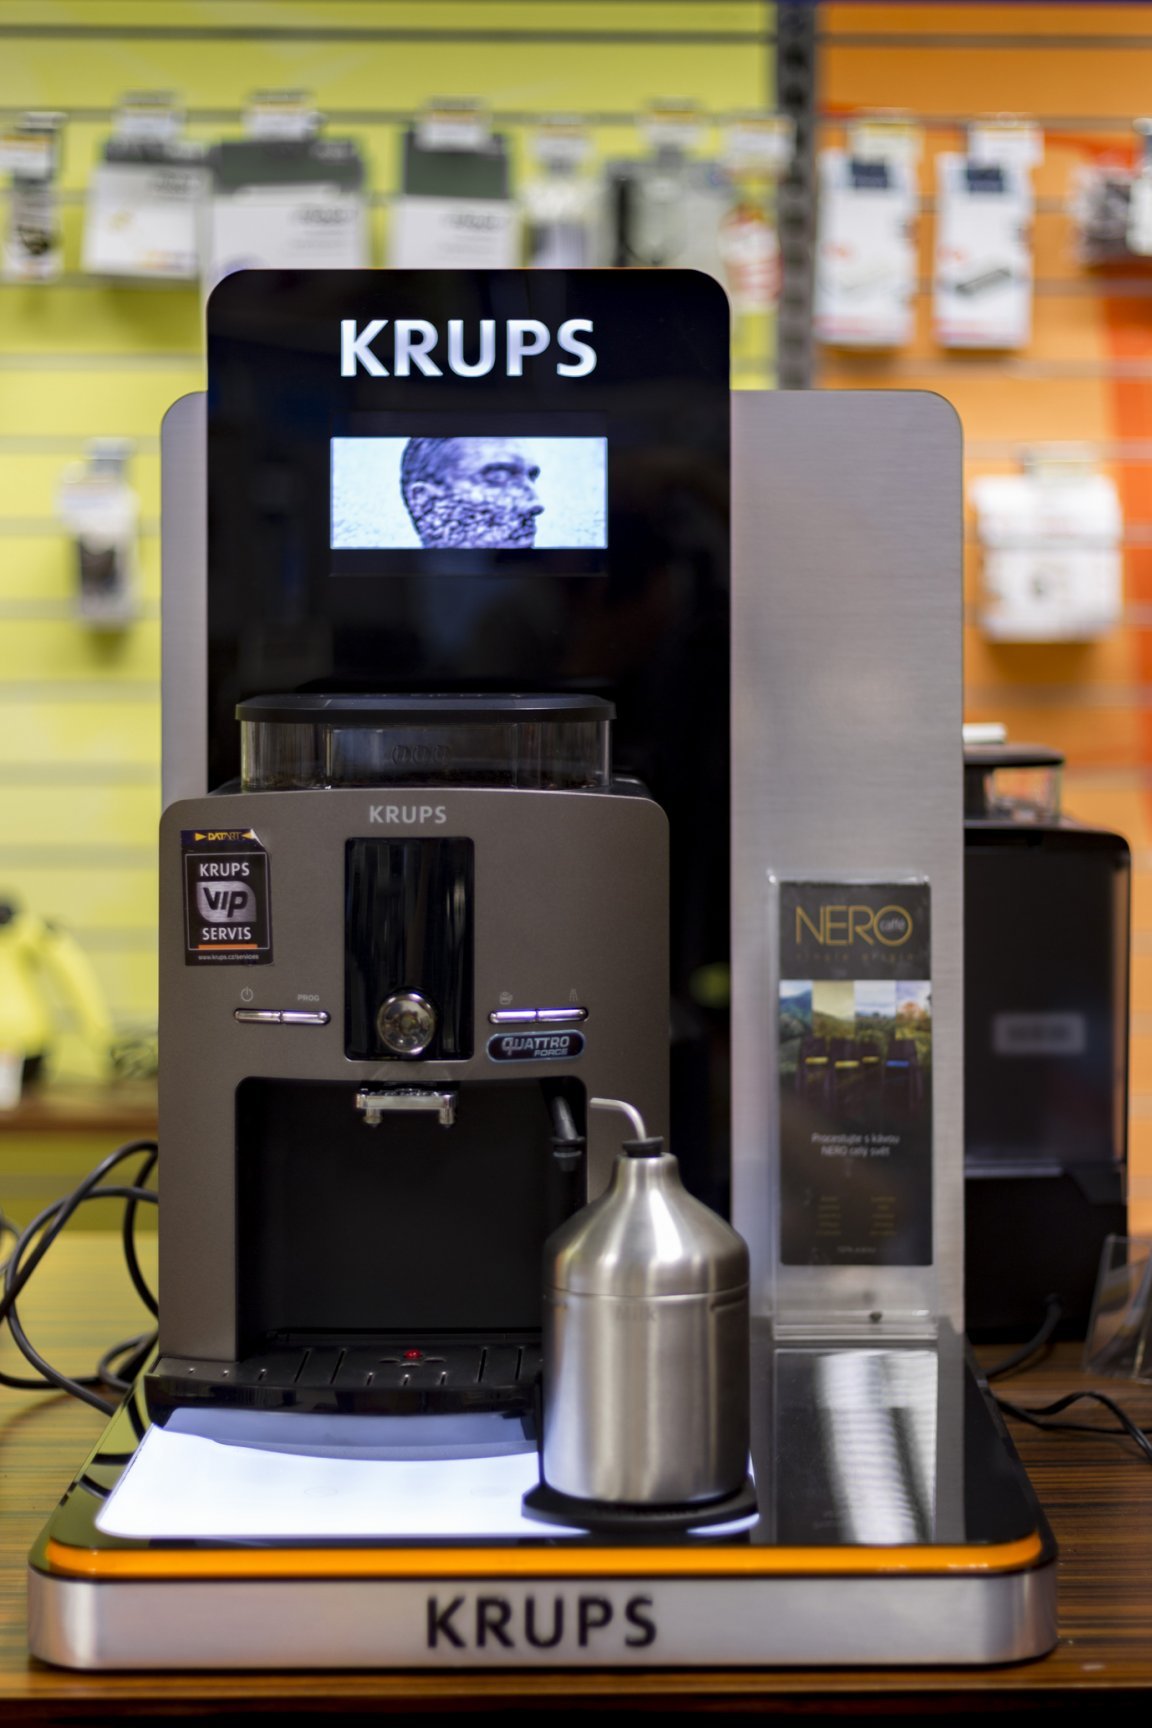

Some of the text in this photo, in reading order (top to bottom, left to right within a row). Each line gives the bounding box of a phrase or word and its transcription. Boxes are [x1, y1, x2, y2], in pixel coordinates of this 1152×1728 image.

[340, 318, 598, 377] KRUPS
[369, 805, 447, 824] KRUPS
[200, 862, 250, 876] KRUPS
[203, 887, 248, 918] VIP
[202, 927, 252, 940] SERVIS
[795, 904, 913, 947] NERO
[297, 994, 320, 1002] PROG
[502, 1036, 570, 1056] QUATTRO
[534, 1048, 568, 1056] FORCE
[427, 1595, 657, 1649] KRUPS
